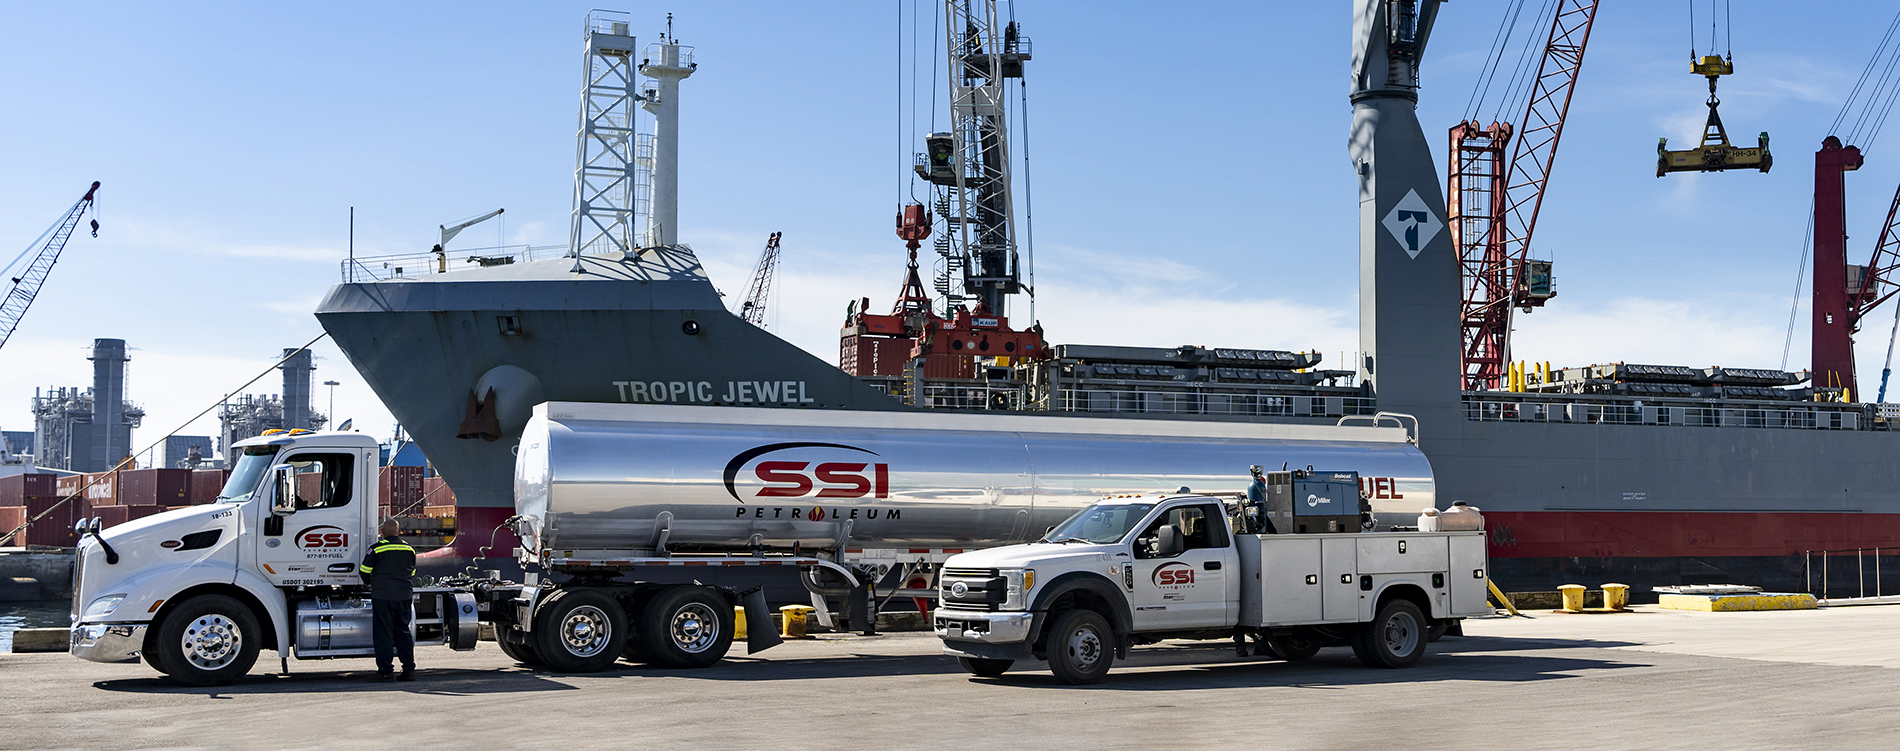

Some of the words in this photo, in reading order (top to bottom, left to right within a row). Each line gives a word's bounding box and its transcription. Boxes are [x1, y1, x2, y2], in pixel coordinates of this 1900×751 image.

[612, 380, 713, 403] TROPIC
[722, 380, 815, 404] JEWEL
[87, 475, 113, 504] Tropical
[755, 460, 890, 499] SSI
[1358, 477, 1404, 500] UEL
[211, 511, 233, 520] 18-133
[735, 505, 901, 522] PETROLEUM
[304, 533, 349, 548] SSI
[1159, 569, 1195, 585] SSI
